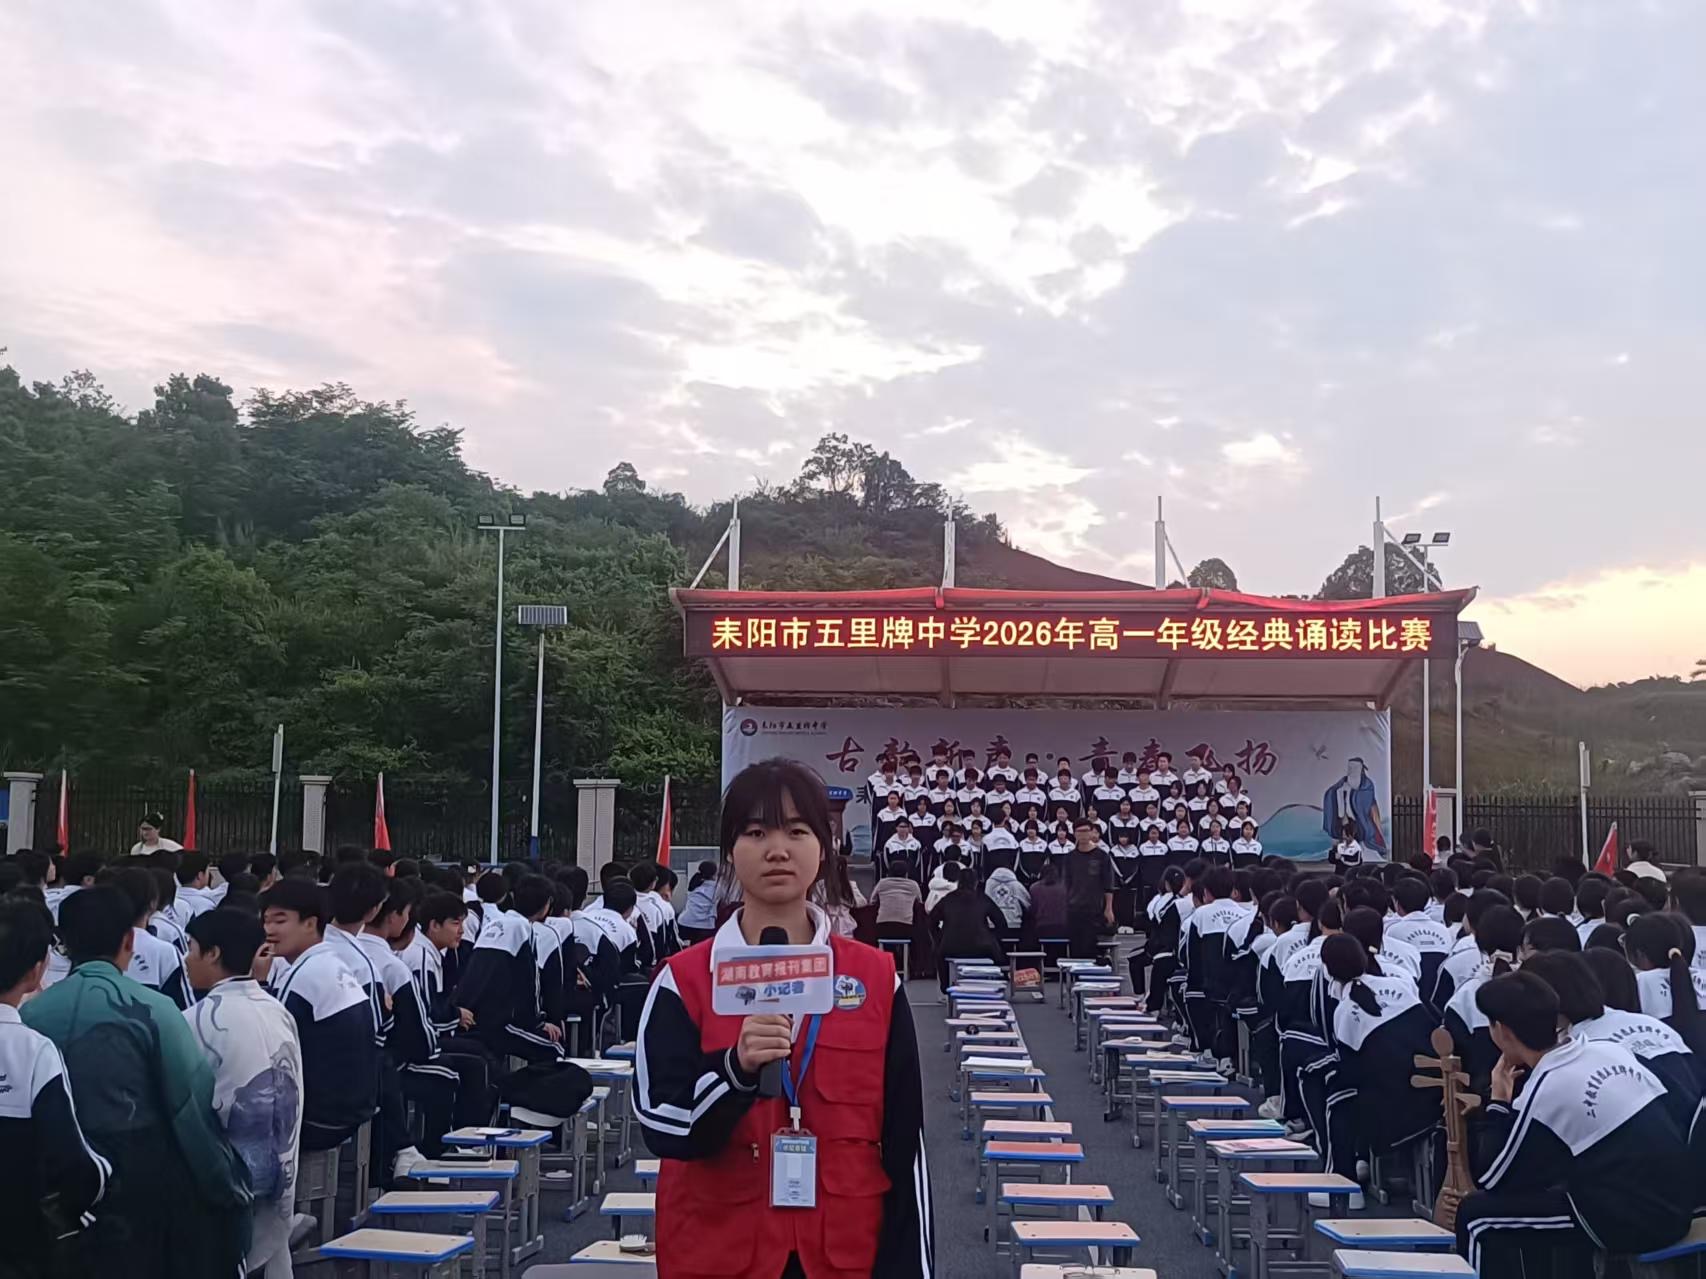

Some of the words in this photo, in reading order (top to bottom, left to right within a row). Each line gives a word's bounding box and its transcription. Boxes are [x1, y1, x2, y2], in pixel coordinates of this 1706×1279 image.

[712, 616, 1432, 650] 耒阳市五里牌中学2026年高一年级经典诵读比赛
[764, 981, 804, 997] 小记者
